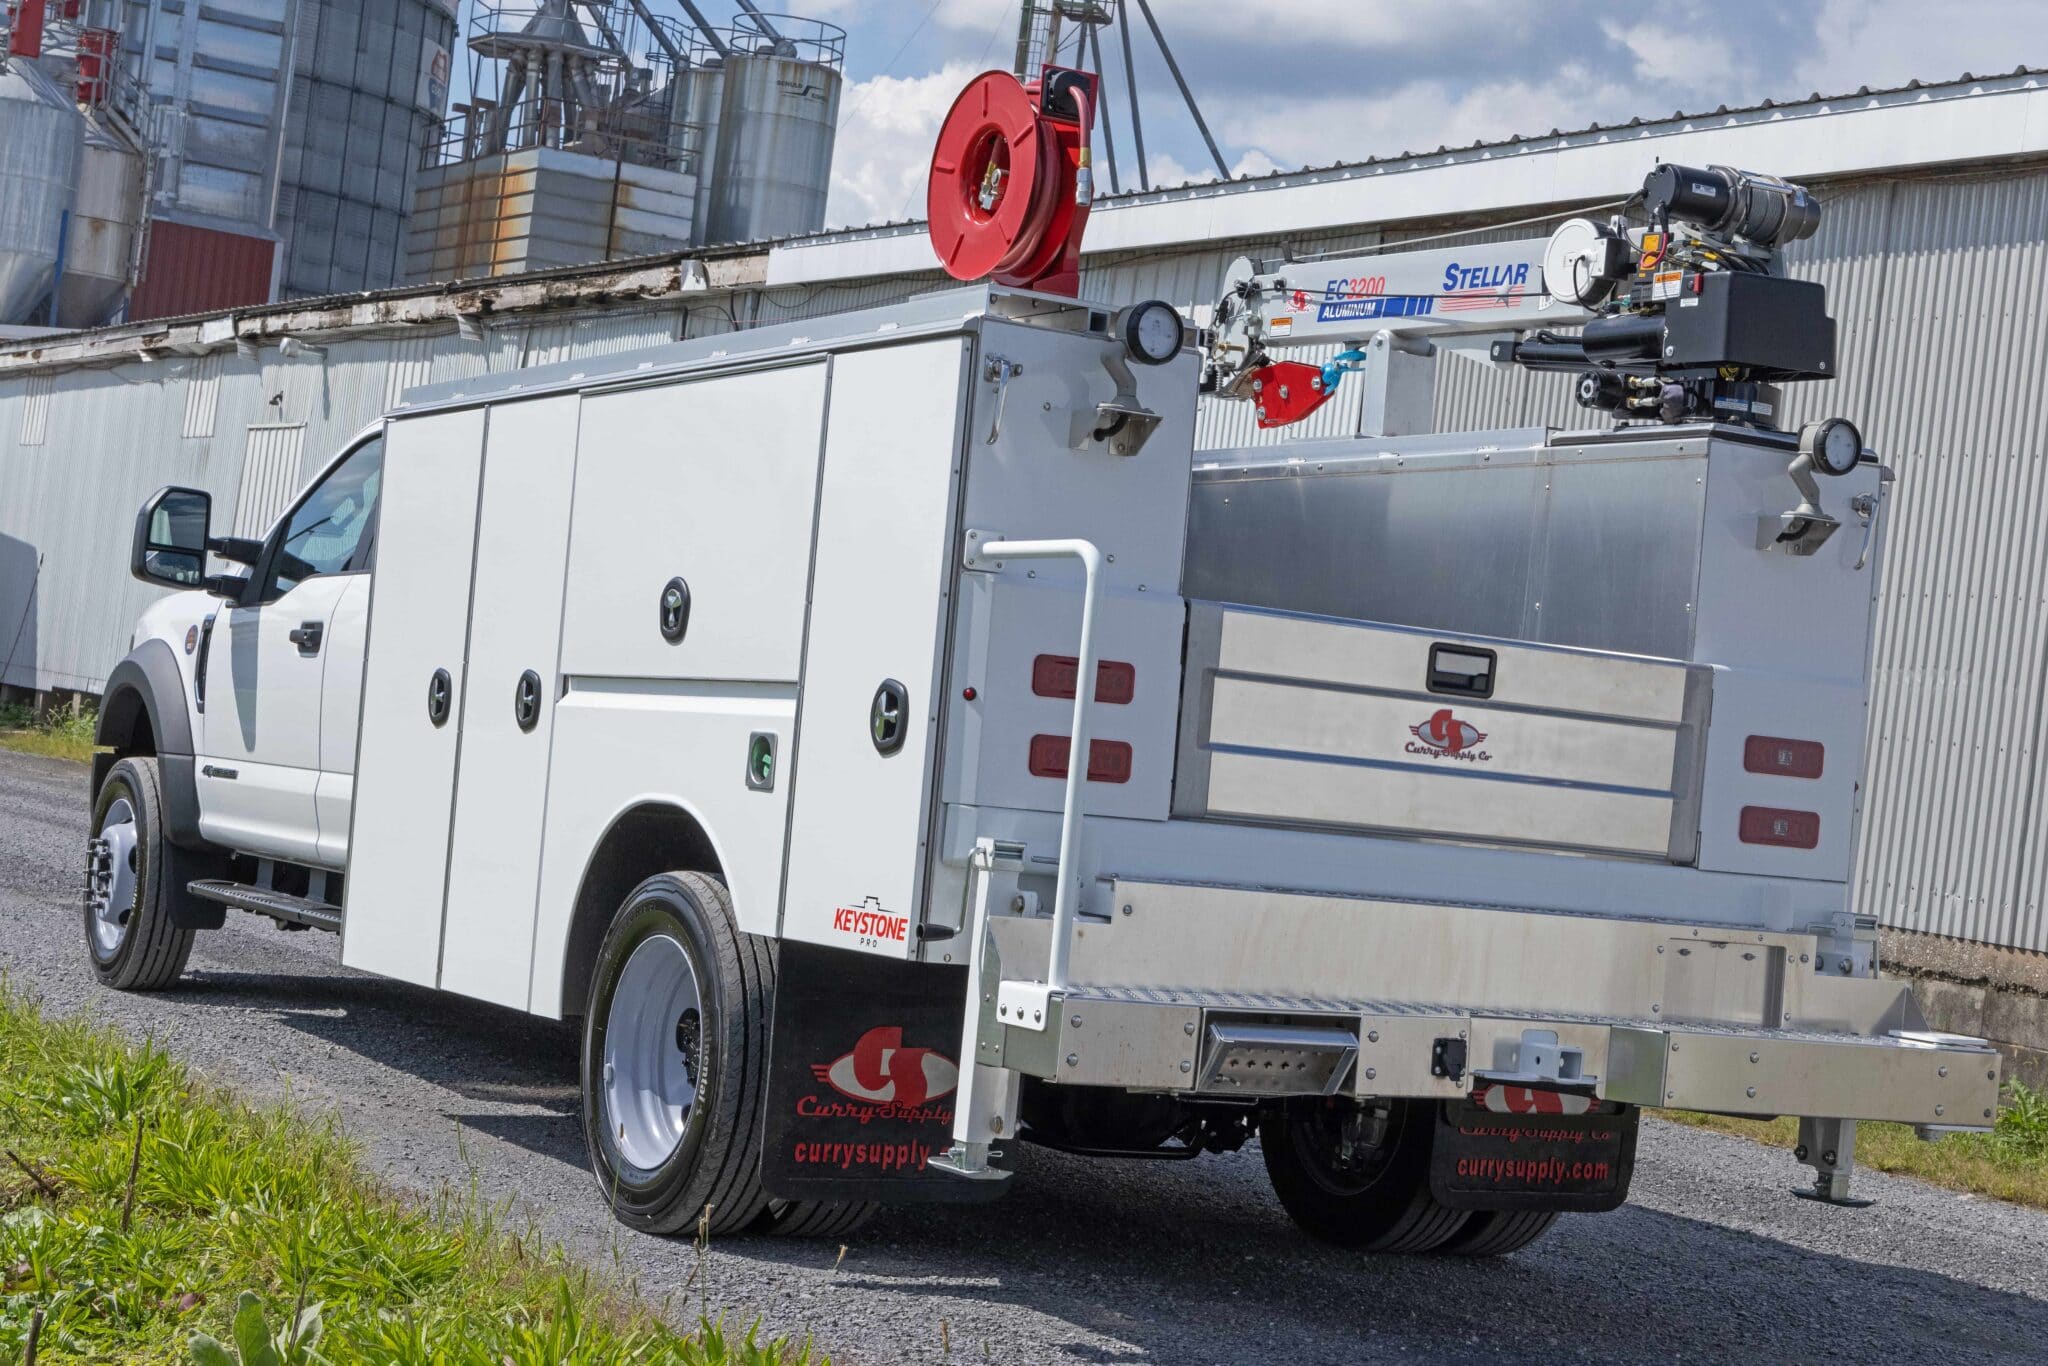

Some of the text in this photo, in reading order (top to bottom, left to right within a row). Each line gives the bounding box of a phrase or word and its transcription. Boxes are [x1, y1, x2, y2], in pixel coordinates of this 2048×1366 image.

[1325, 276, 1386, 301] EC3200
[1442, 262, 1529, 292] STELLAR
[1322, 302, 1376, 319] ALUMINUM
[1405, 741, 1440, 759] Curry
[1441, 748, 1476, 762] Supply
[833, 907, 908, 941] KEYSTONE
[860, 937, 877, 948] PRO
[796, 1095, 953, 1125] Curry Supply
[794, 1138, 950, 1171] currysupply
[1457, 1156, 1609, 1185] currysupply.com
